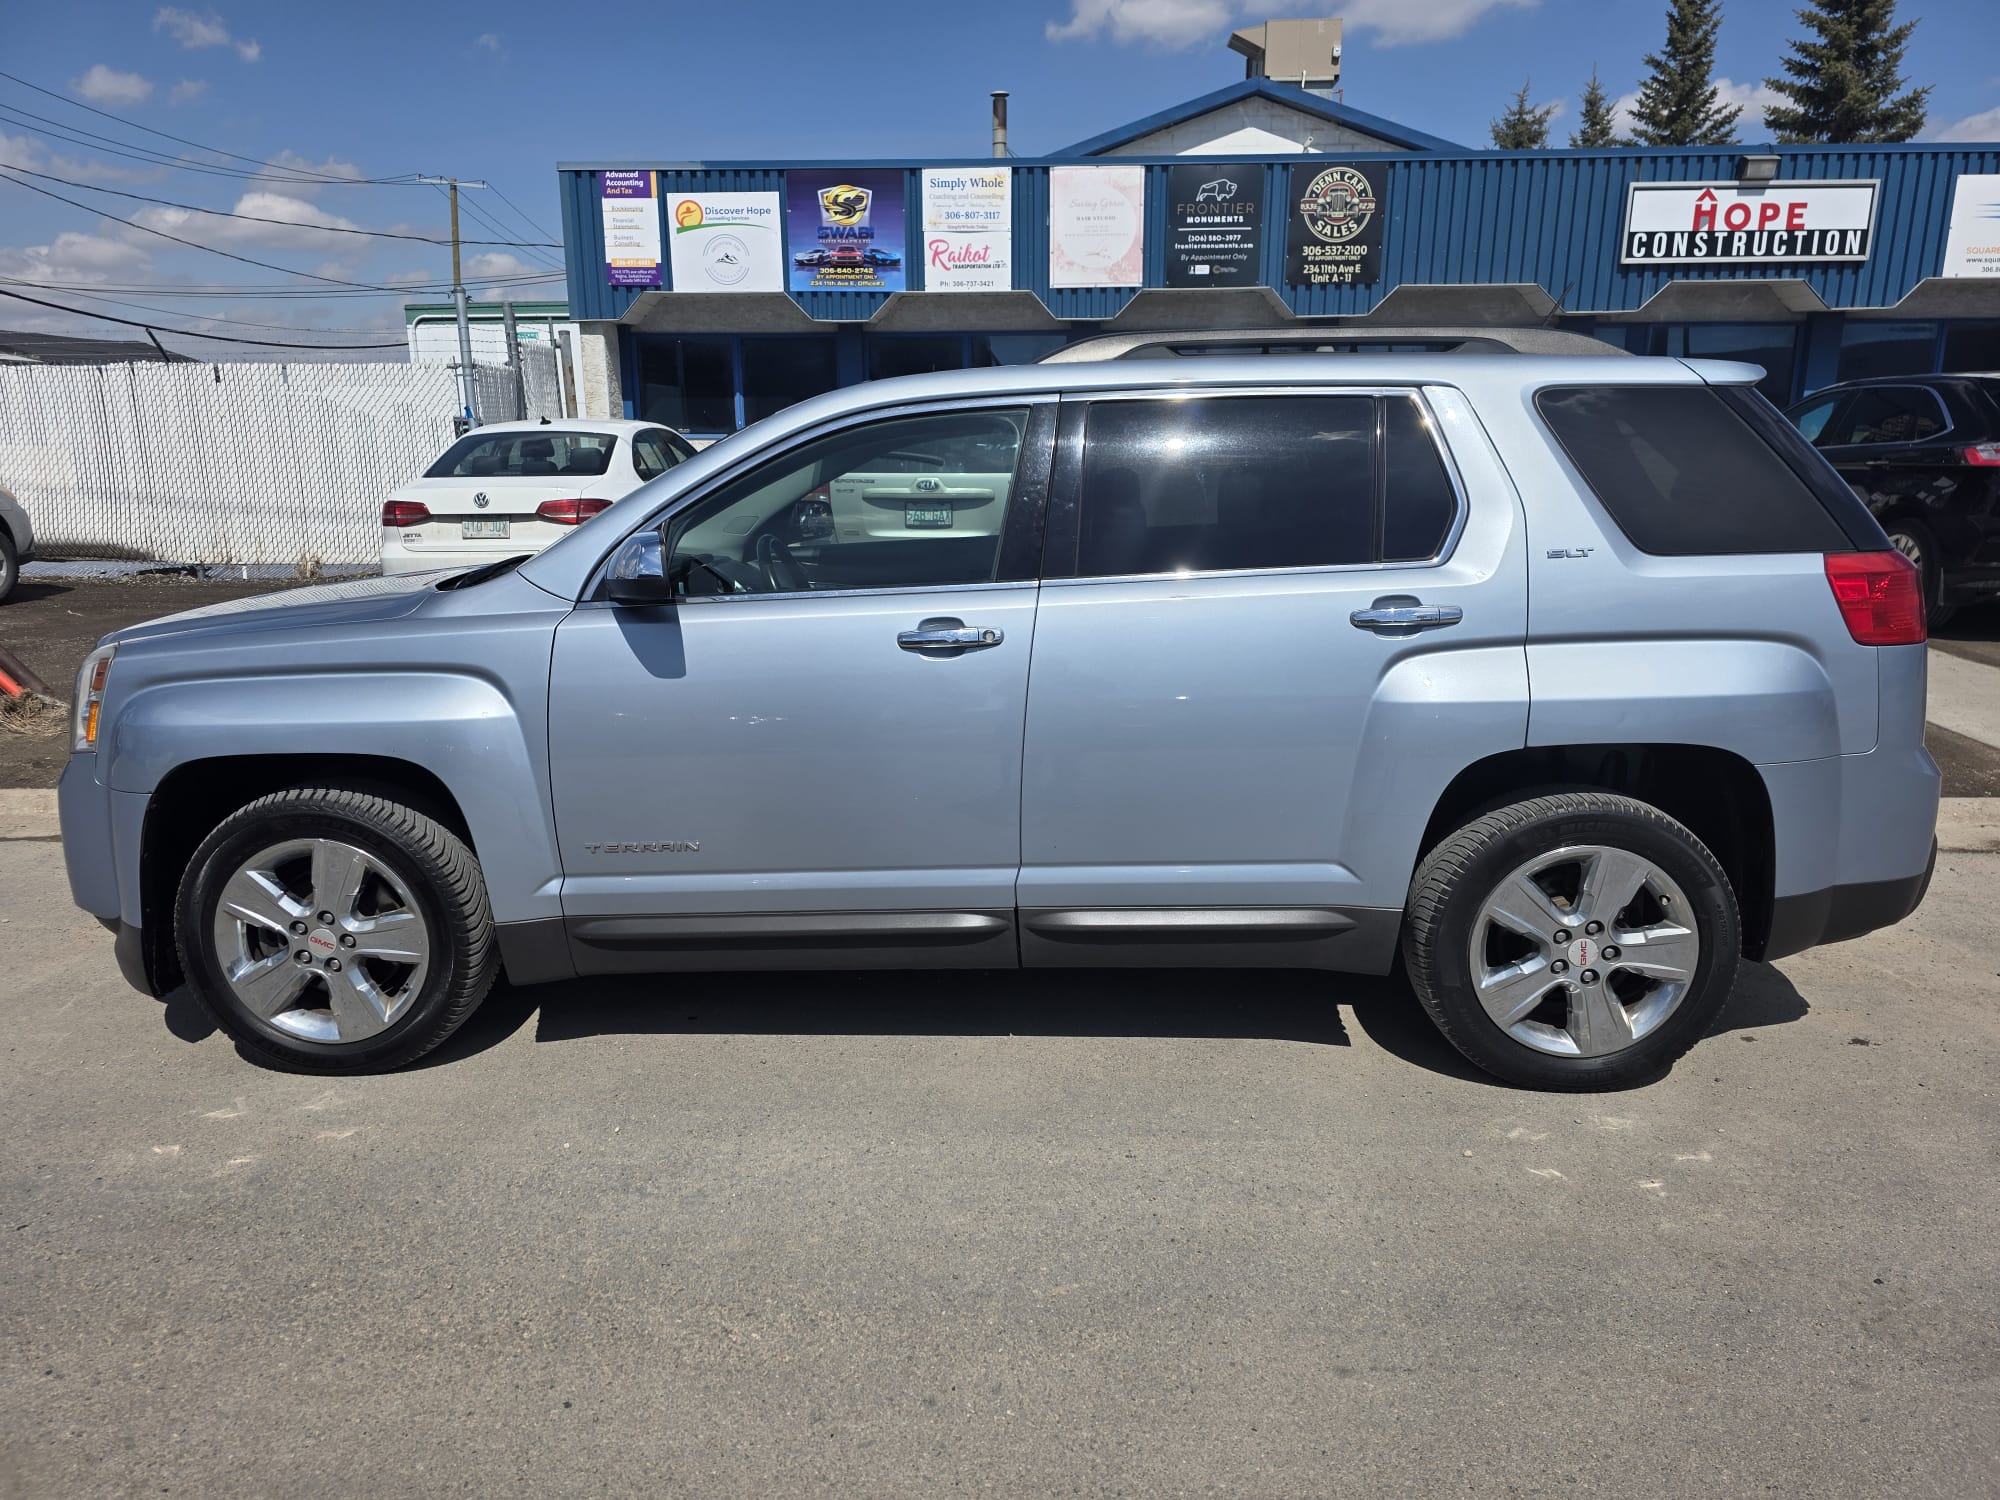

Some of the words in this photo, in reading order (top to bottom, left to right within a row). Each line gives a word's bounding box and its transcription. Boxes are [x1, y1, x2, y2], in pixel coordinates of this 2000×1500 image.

[605, 171, 639, 179] Advanced
[606, 179, 644, 188] Accounting
[930, 178, 967, 191] Simply
[969, 178, 1004, 188] Whole
[1313, 172, 1341, 194] DENN
[1343, 172, 1365, 192] CAR
[607, 187, 620, 195] And
[621, 187, 633, 195] Tax
[929, 193, 957, 201] Coaching
[704, 207, 745, 215] Discover
[746, 207, 771, 216] Hope
[1177, 203, 1255, 215] FRONTIER
[944, 211, 1001, 220] 306-807-3117
[1691, 197, 1809, 232] HOPE
[1314, 219, 1359, 238] SALES
[1188, 235, 1207, 243] (306)
[1631, 230, 1862, 258] CONSTRUCTION
[1175, 242, 1254, 250] frontiermonuments.com
[1302, 246, 1368, 256] 306-537-2100
[928, 239, 991, 271] Raikot
[1181, 254, 1190, 262] By
[1190, 253, 1231, 262] Appointment
[1232, 253, 1248, 262] Only
[1303, 265, 1320, 273] 234
[1321, 264, 1337, 273] 11th
[1338, 264, 1355, 272] Ave
[1355, 264, 1361, 272] E
[1311, 274, 1330, 283] Unit
[1331, 273, 1339, 282] A
[919, 480, 936, 489] KIA
[1546, 548, 1594, 559] SLT
[584, 841, 700, 854] TERRAIN
[310, 936, 335, 950] GMC
[1580, 940, 1588, 966] GMC
